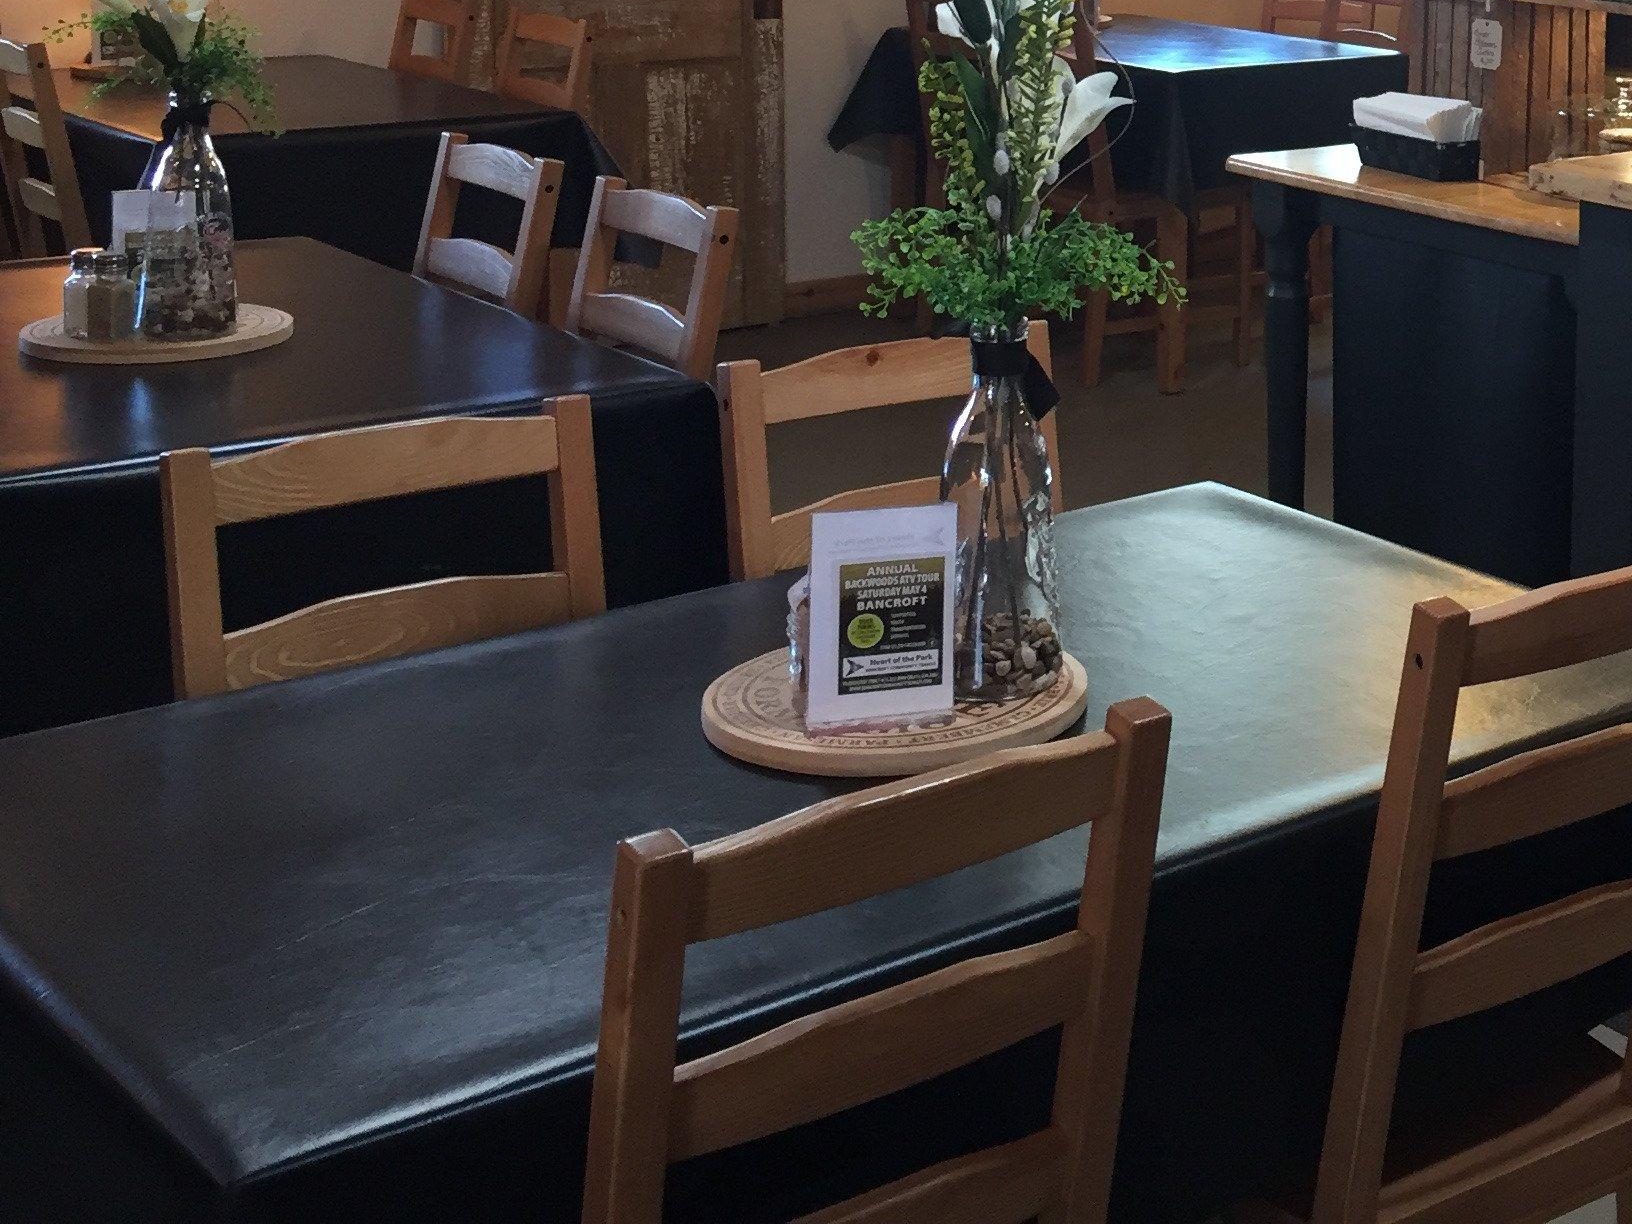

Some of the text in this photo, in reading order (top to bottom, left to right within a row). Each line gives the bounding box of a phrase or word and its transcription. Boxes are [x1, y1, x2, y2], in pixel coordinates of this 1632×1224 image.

[866, 564, 919, 577] ANNUAL
[856, 586, 902, 600] SATURDAY
[902, 585, 919, 596] MAY
[856, 596, 928, 612] BANCROFT
[869, 657, 891, 666] Heart
[902, 655, 914, 663] the
[915, 653, 933, 661] Park
